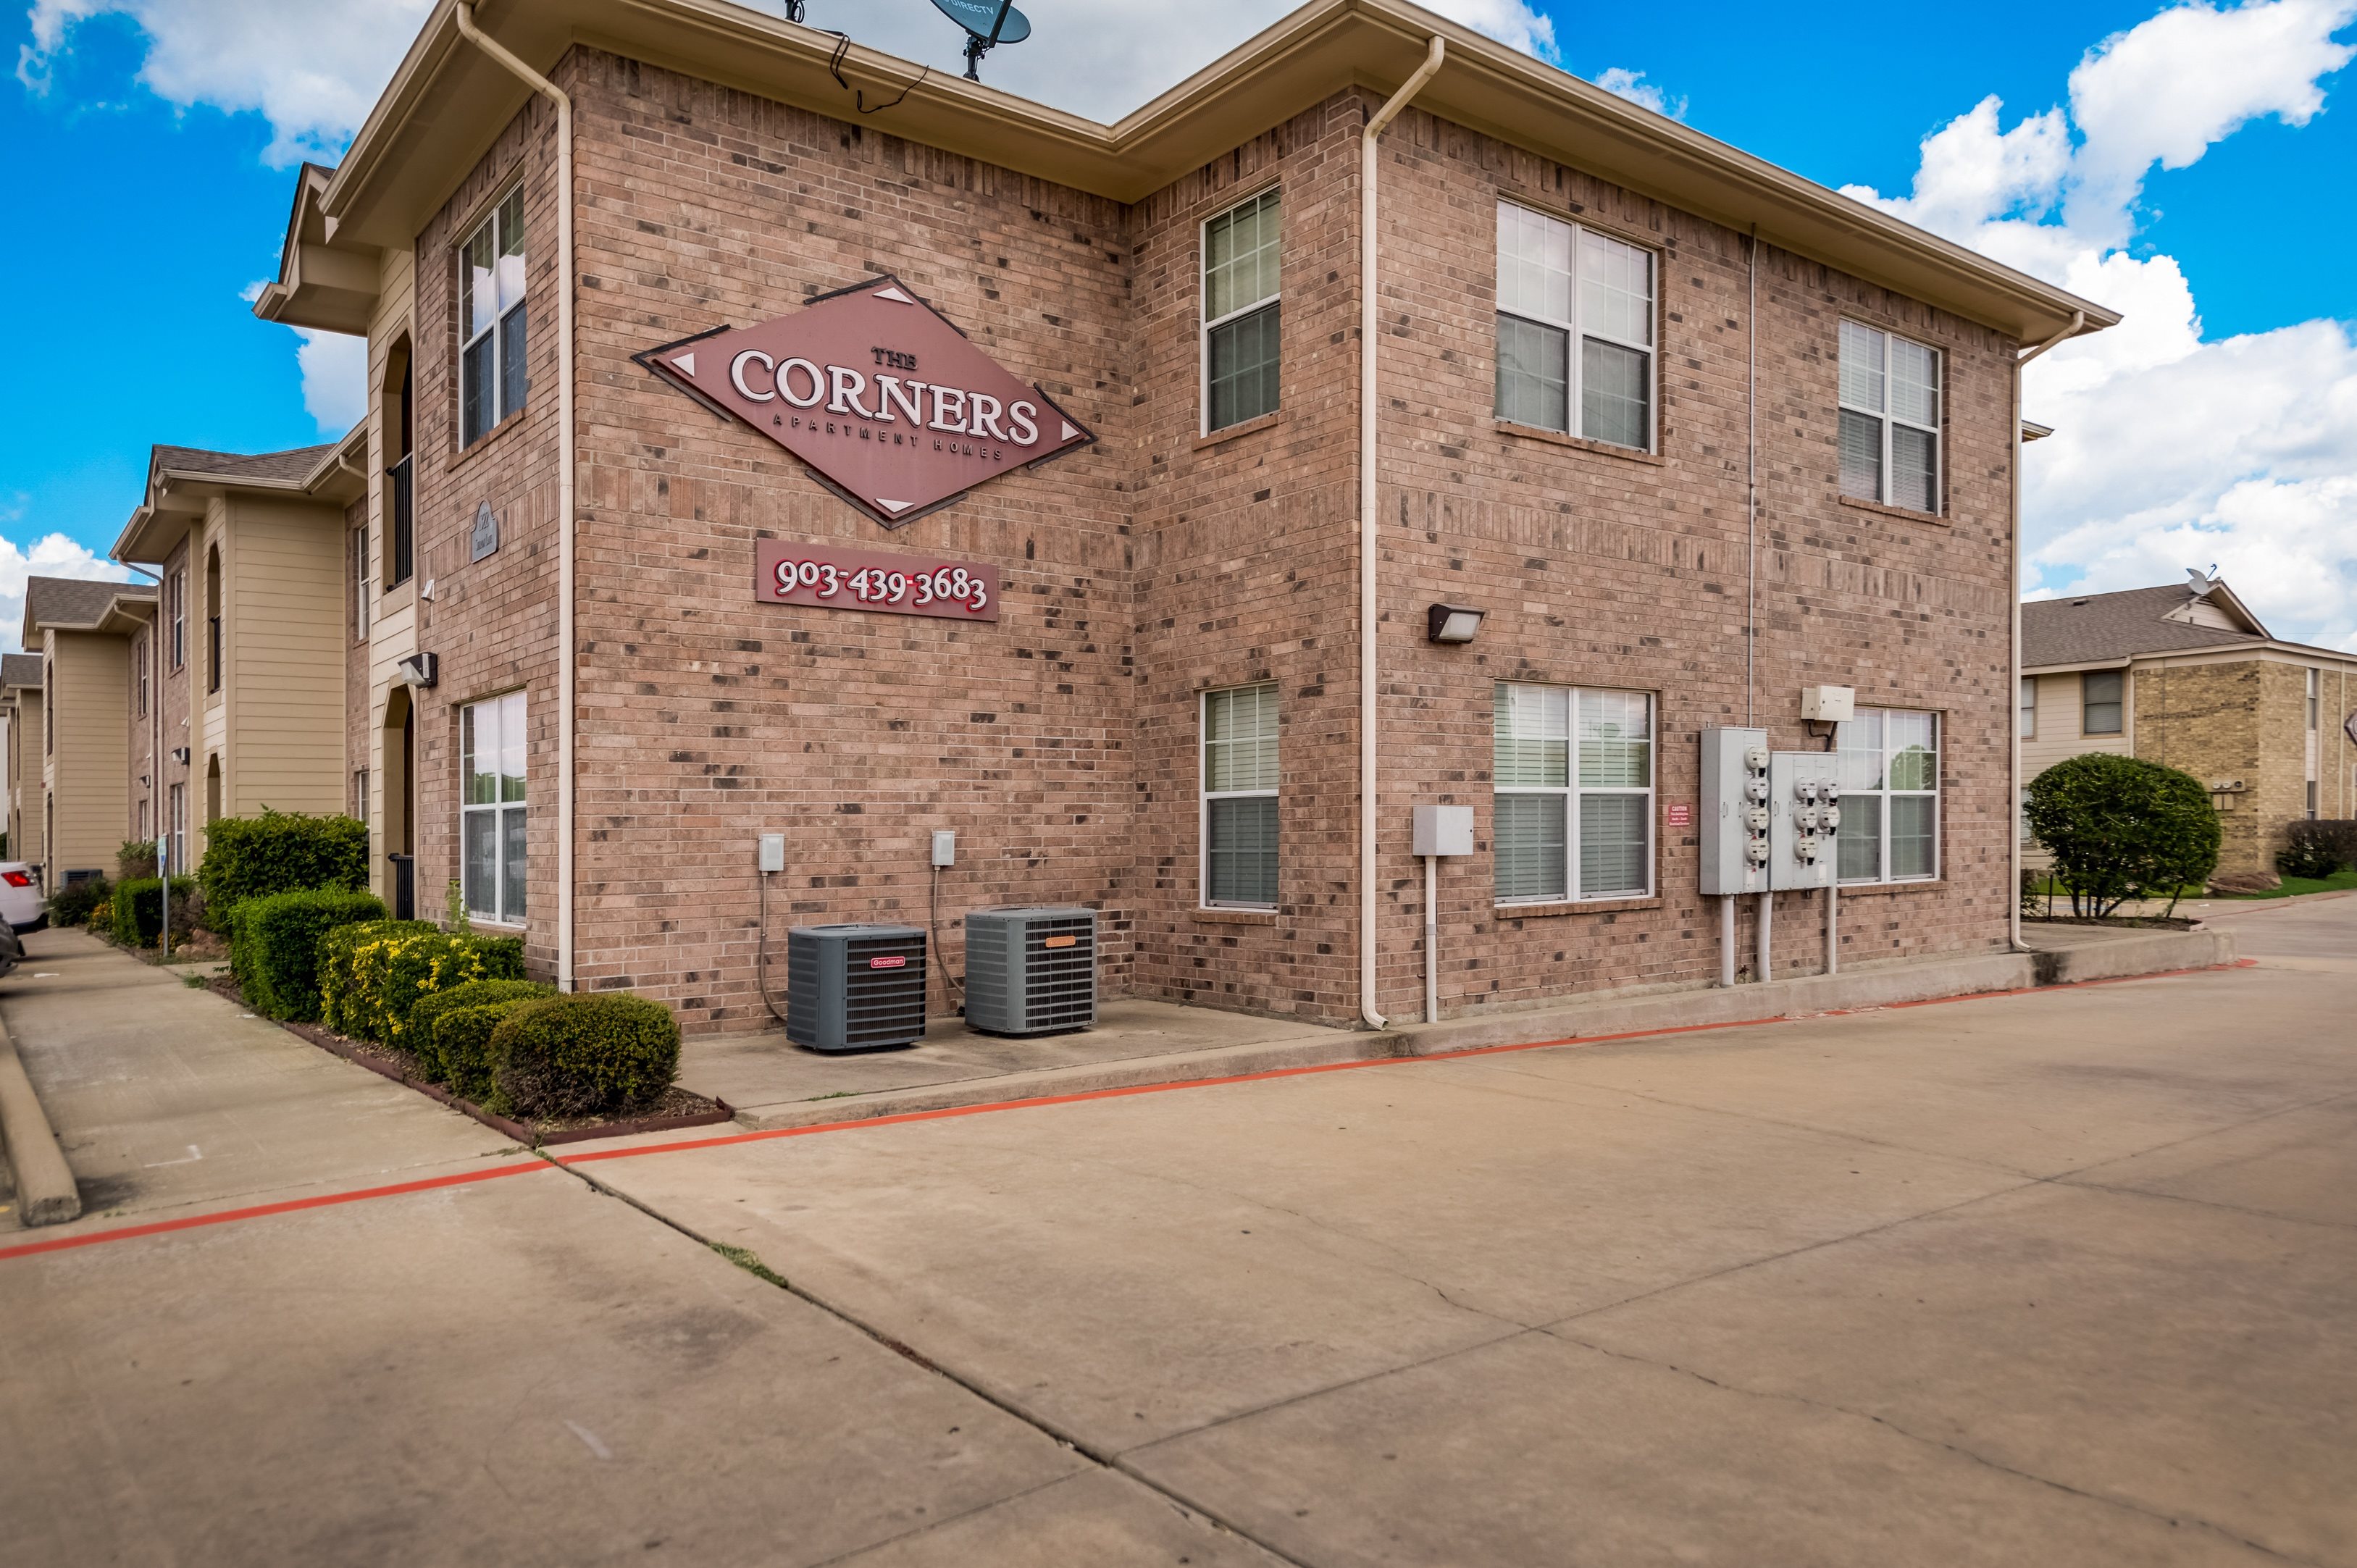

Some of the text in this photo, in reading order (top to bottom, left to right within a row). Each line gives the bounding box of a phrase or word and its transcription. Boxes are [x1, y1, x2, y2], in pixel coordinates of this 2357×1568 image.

[950, 0, 994, 14] DIRECTV
[871, 346, 918, 371] THE
[729, 348, 1039, 447] CORNERS
[773, 413, 1002, 460] APARTMENT HOMES
[776, 561, 987, 610] 903-439-3683
